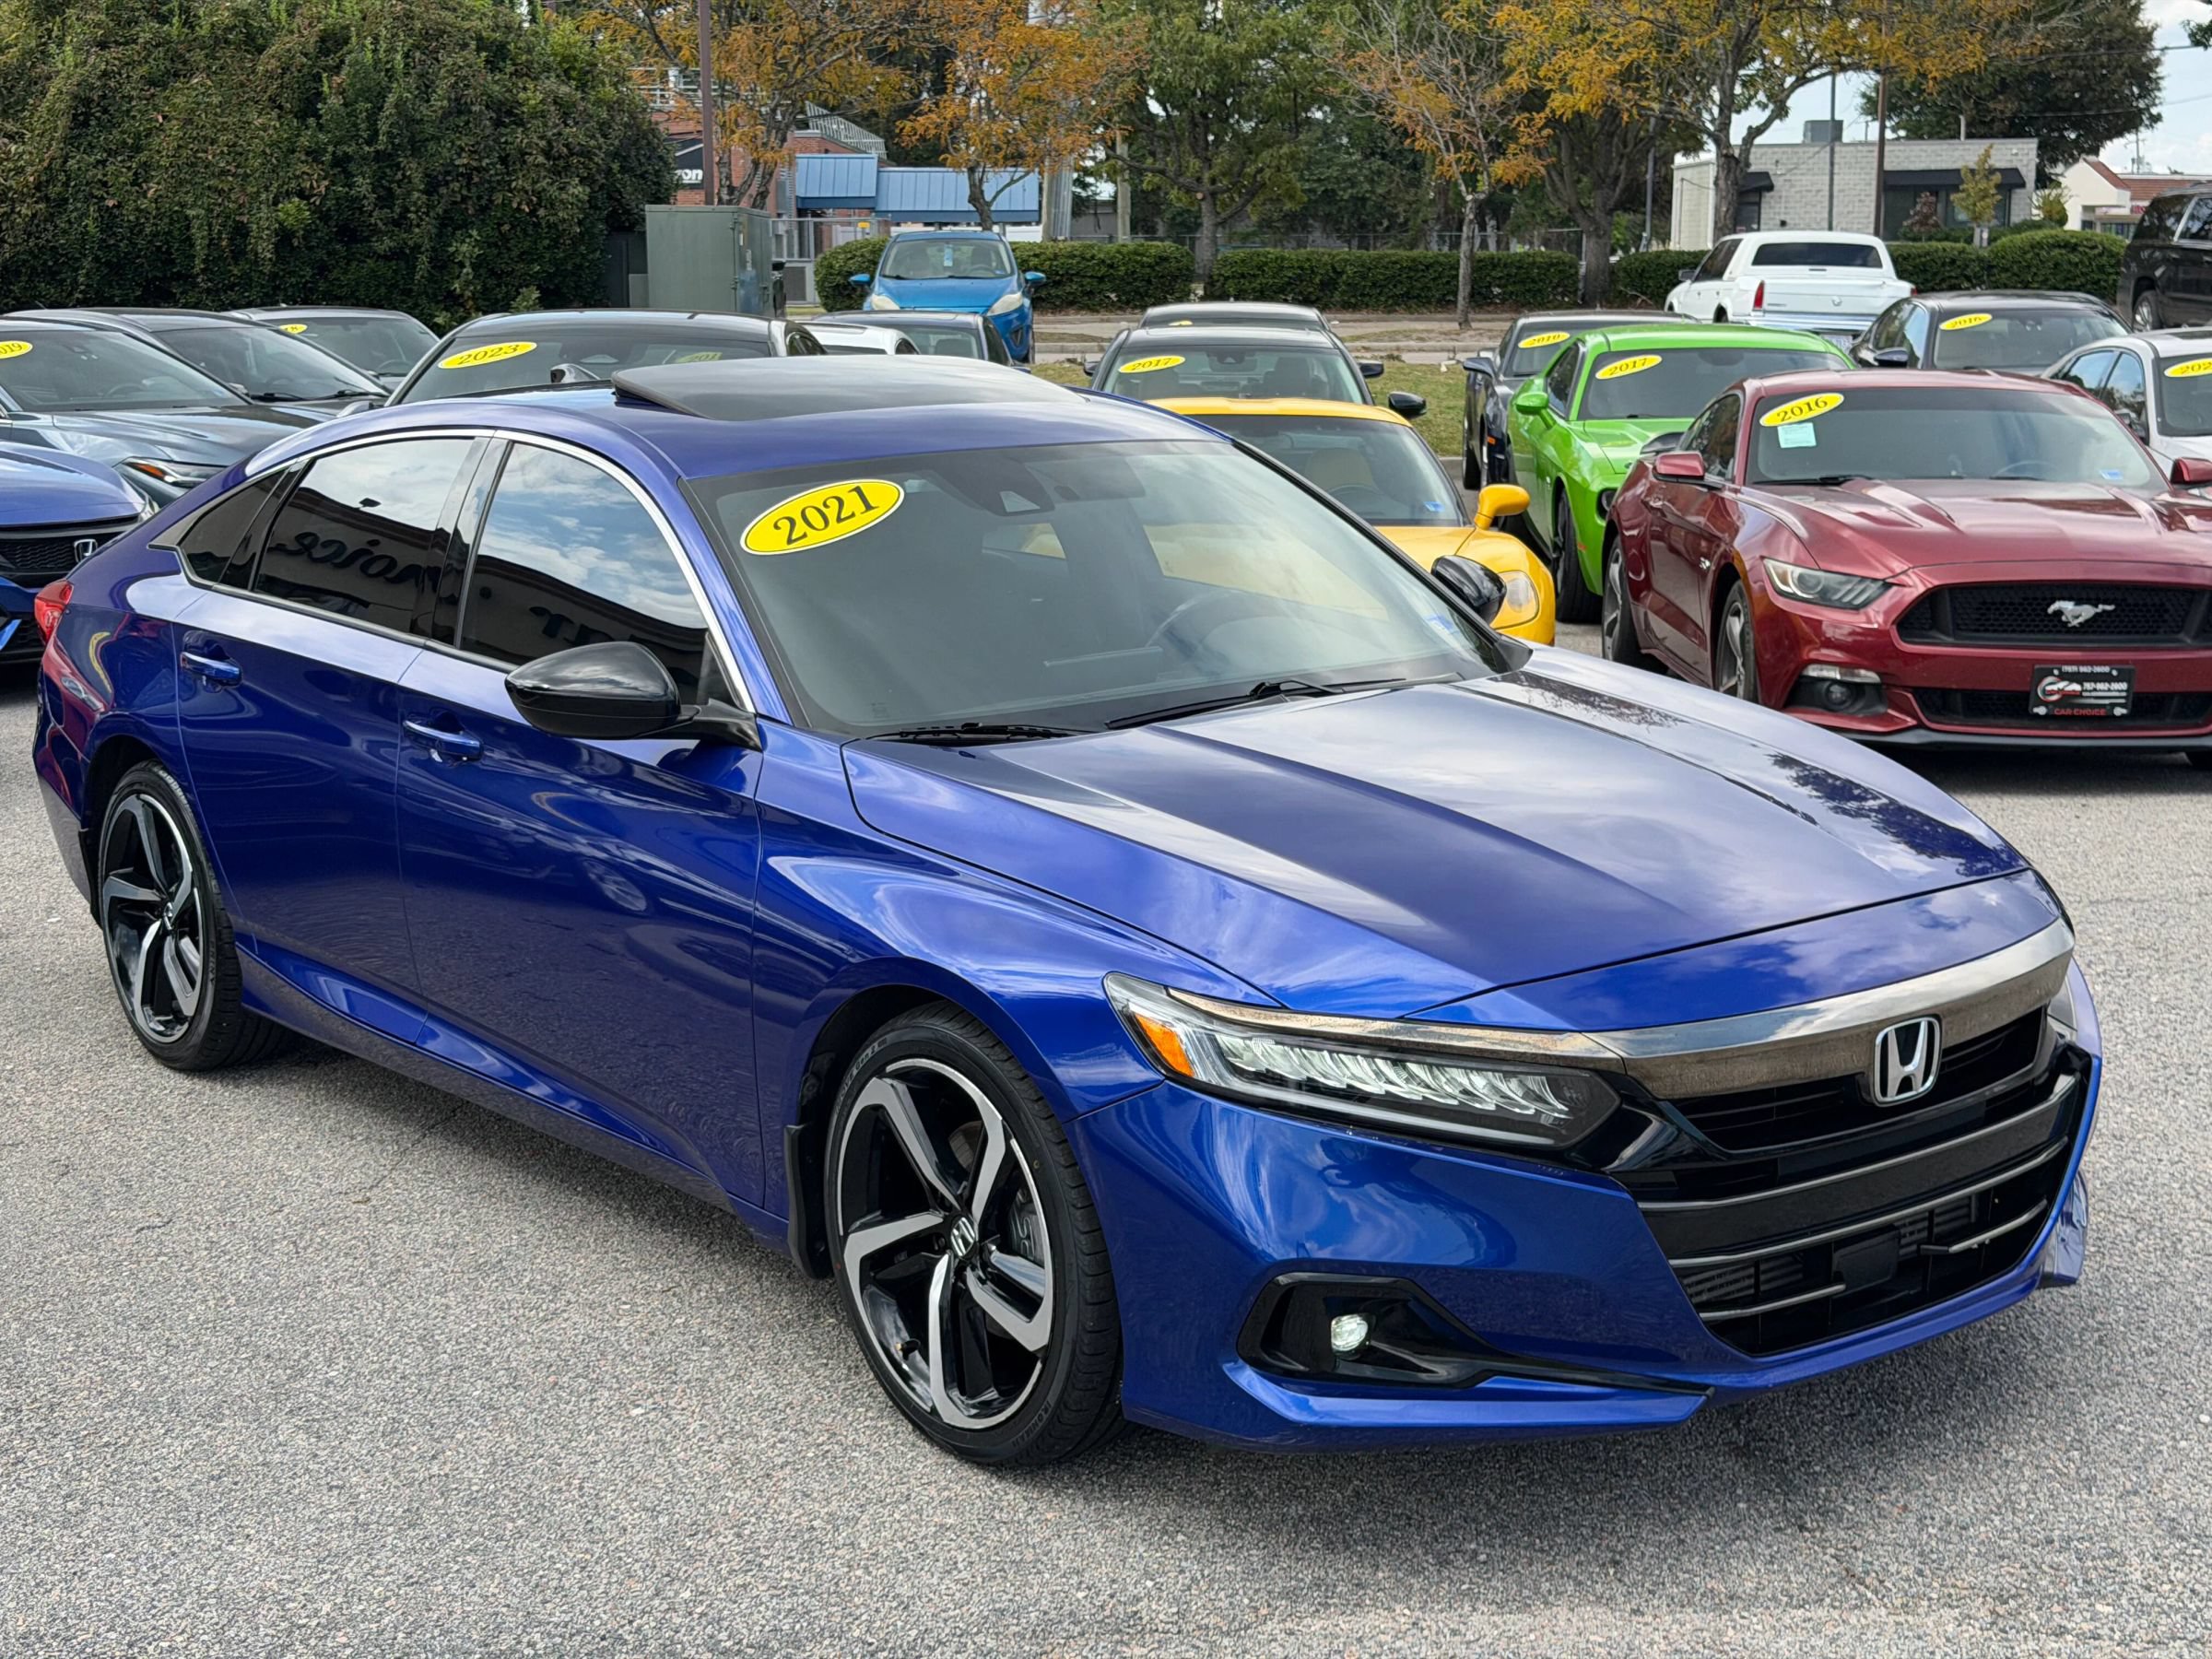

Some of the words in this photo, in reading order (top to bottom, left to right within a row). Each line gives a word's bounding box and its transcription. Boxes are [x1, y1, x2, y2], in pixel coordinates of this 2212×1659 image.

[457, 344, 520, 365] 2023
[1609, 357, 1648, 376] 2017
[1777, 396, 1828, 422] 2016
[773, 485, 879, 546] 2021
